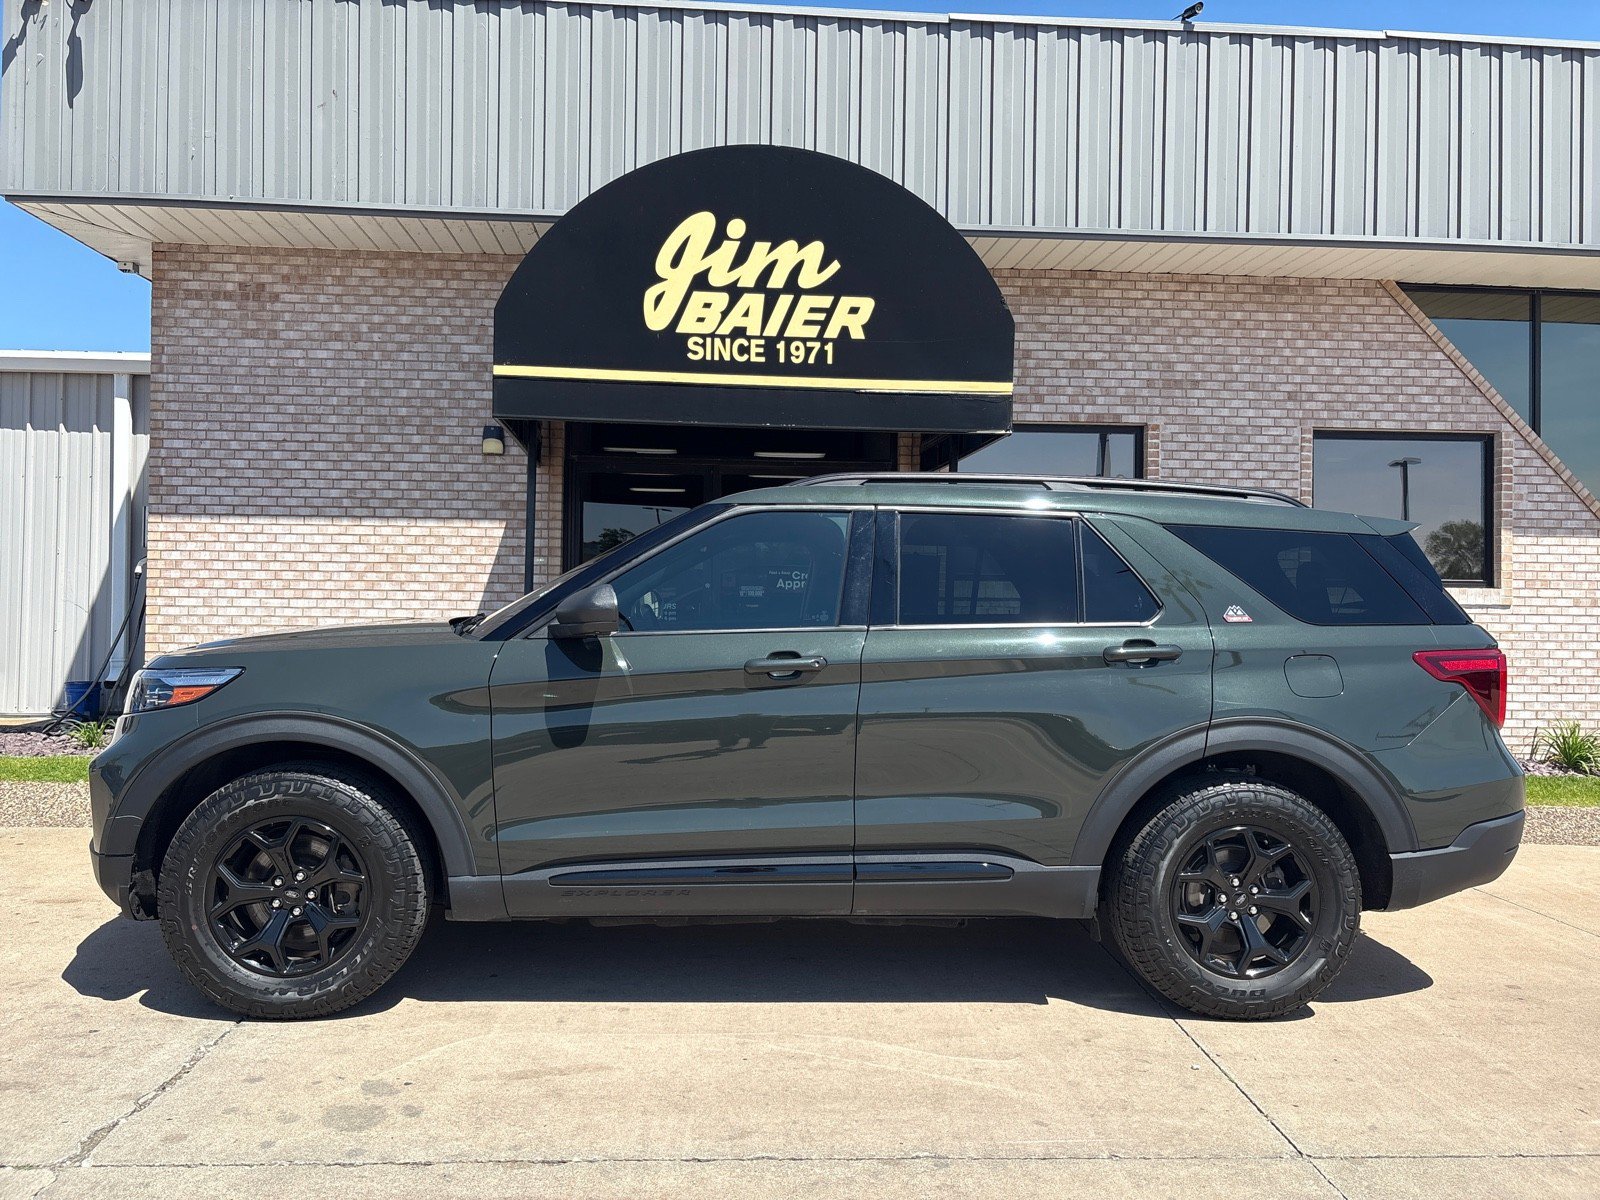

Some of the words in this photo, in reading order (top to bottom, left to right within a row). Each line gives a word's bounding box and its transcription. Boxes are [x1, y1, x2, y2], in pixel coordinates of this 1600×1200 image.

[643, 210, 841, 332] Jim
[675, 290, 876, 340] BAIER
[686, 336, 766, 363] SINCE
[776, 340, 834, 365] 1971
[560, 889, 692, 897] EXPLORER
